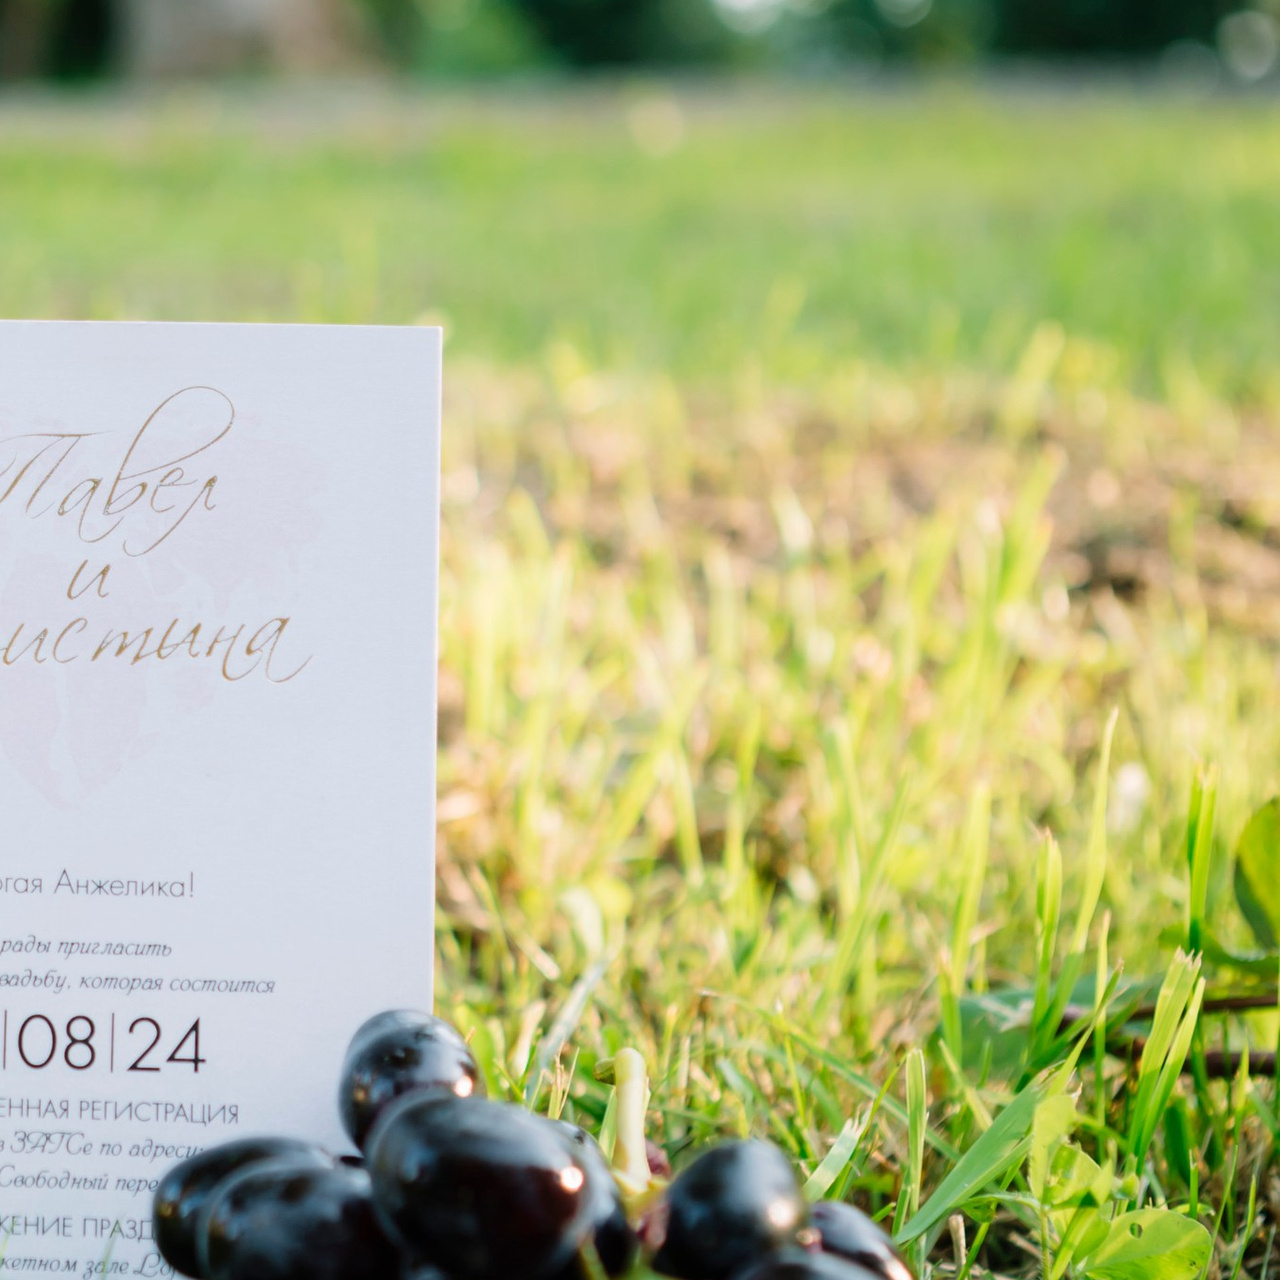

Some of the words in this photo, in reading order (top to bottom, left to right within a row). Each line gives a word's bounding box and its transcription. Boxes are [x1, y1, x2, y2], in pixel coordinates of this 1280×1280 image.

[67, 559, 110, 599] и
[54, 868, 195, 899] Анжелика!
[56, 940, 173, 958] пригласить
[79, 977, 164, 996] которая
[169, 979, 276, 994] состоится
[78, 1100, 239, 1127] РЕГИСТРАЦИЯ
[10, 1130, 93, 1155] ЗАГСе
[99, 1142, 123, 1157] по
[114, 1176, 160, 1198] пере
[82, 1217, 158, 1243] ПРАЗД
[82, 1260, 130, 1280] зале
